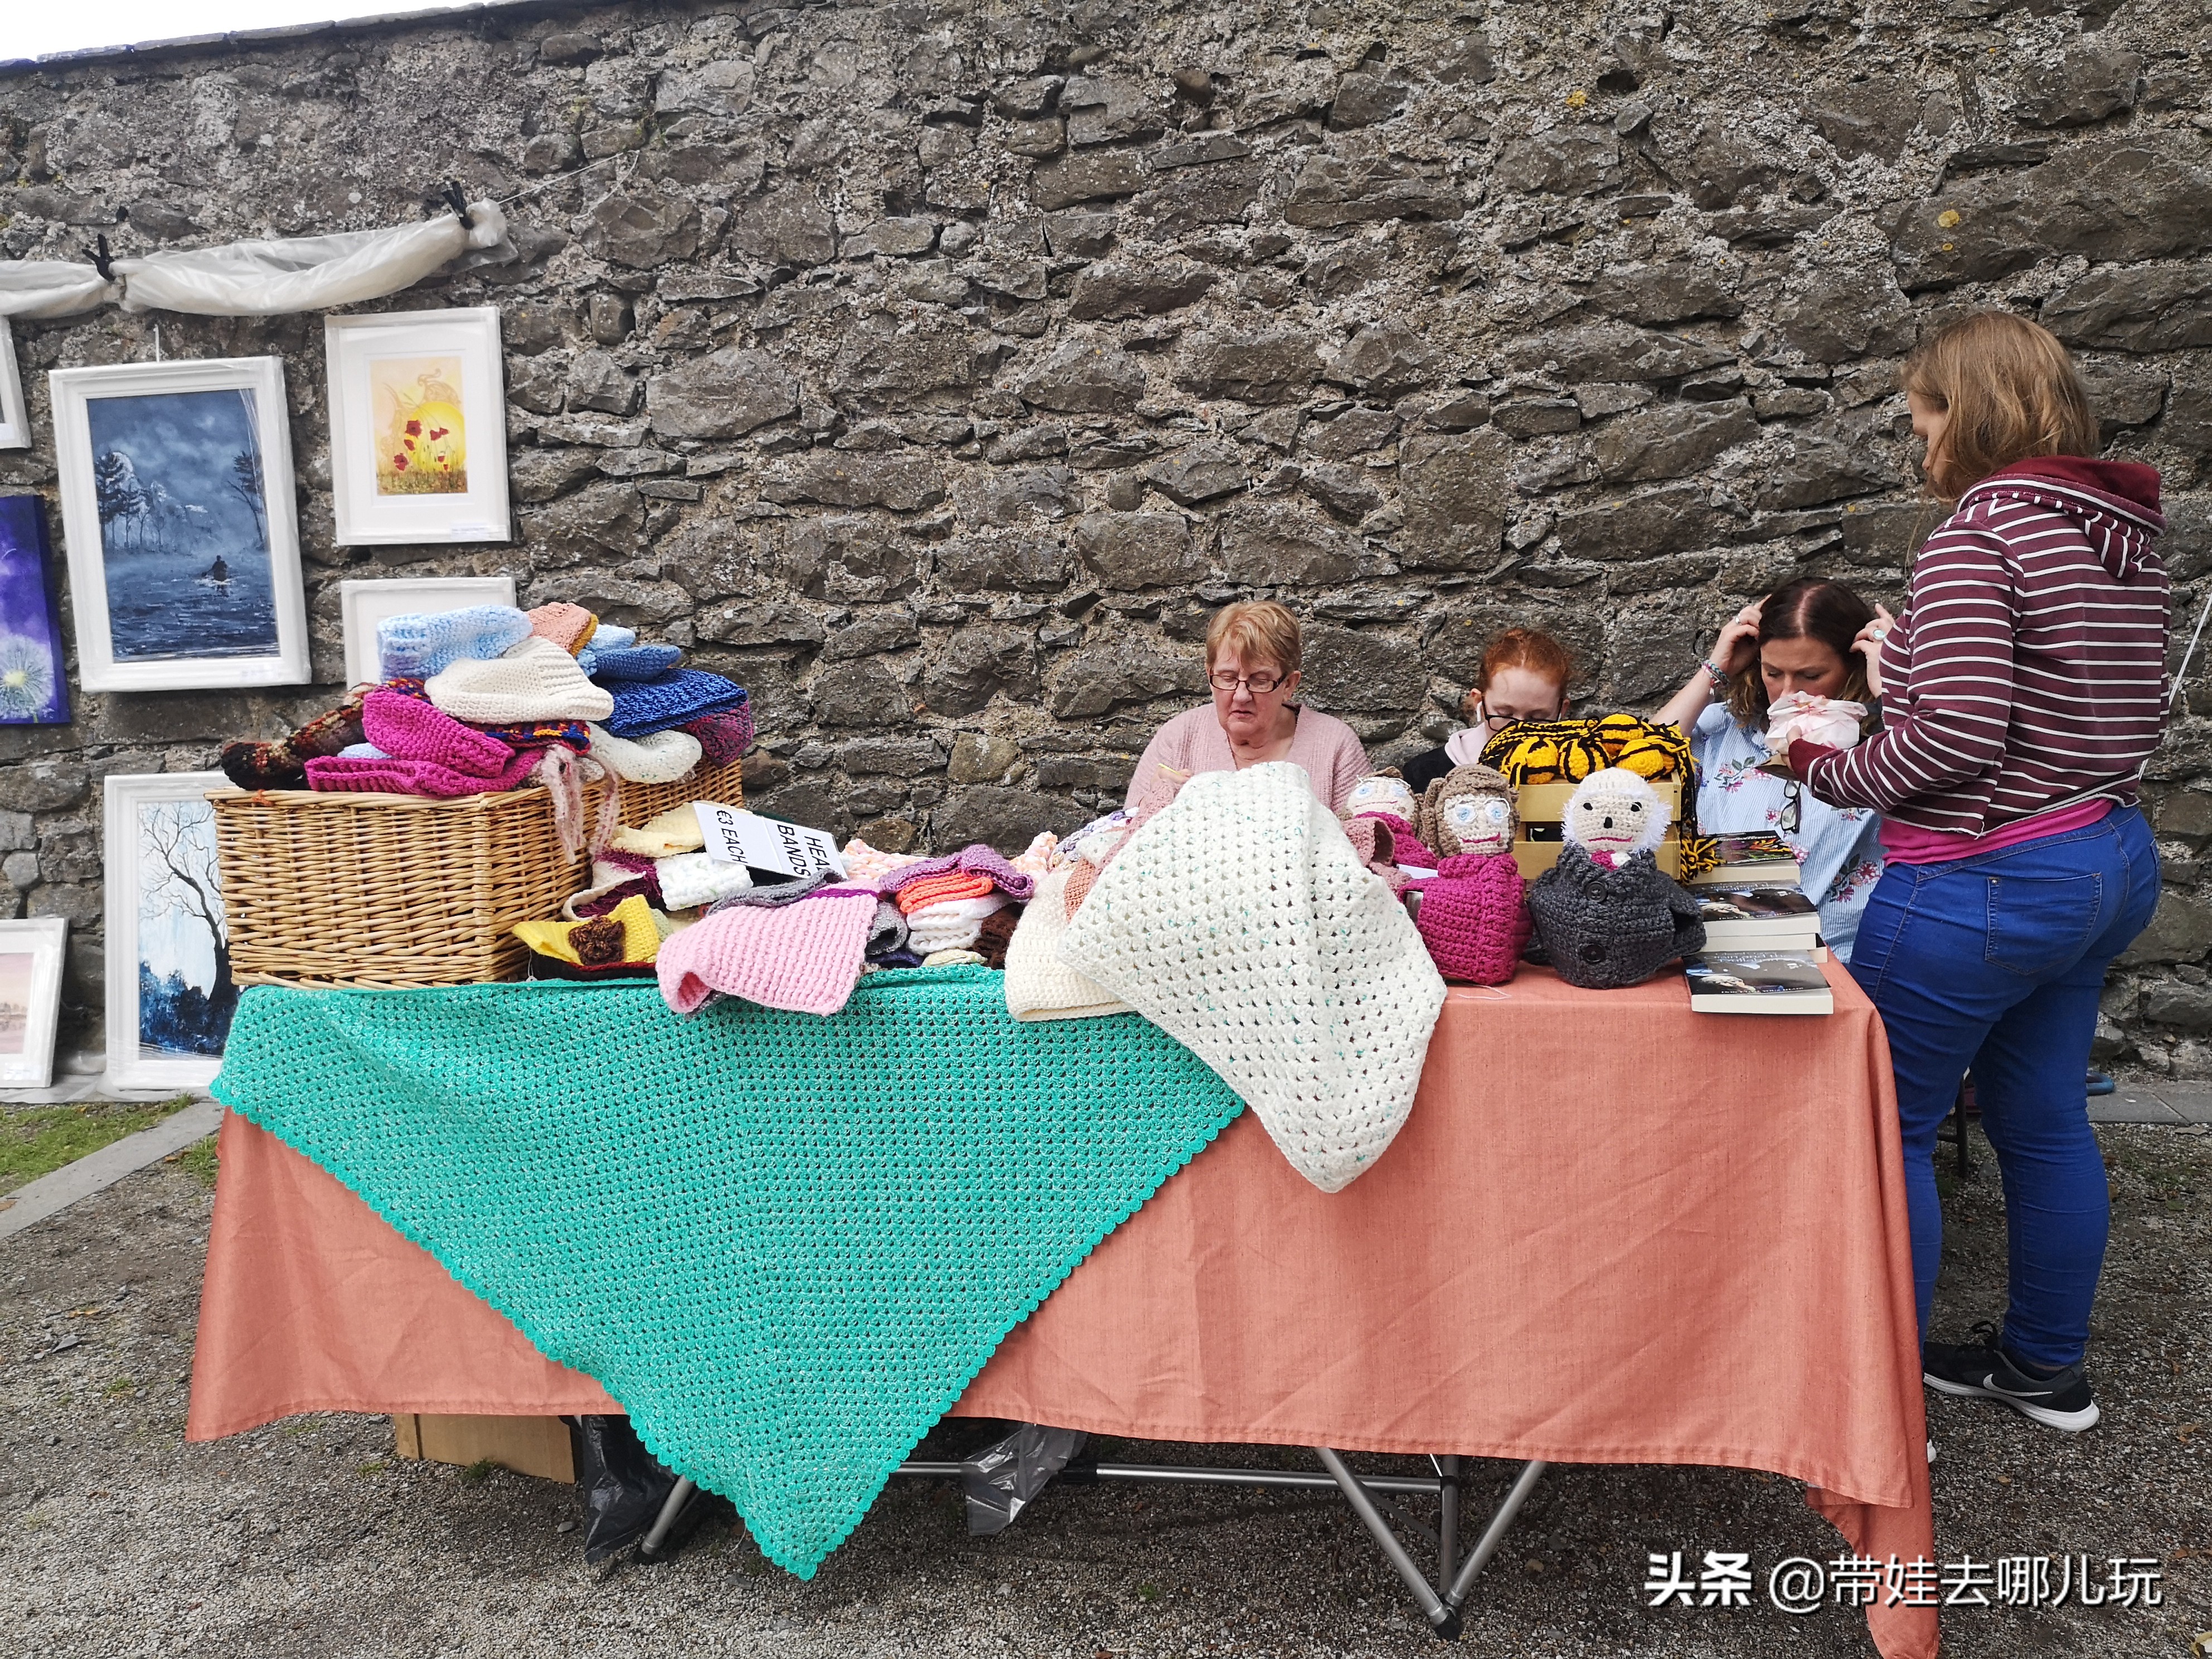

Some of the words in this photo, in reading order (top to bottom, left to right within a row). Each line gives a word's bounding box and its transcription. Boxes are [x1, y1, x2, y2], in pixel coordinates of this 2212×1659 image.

[716, 810, 734, 825] €3
[721, 828, 748, 864] EACH
[777, 824, 811, 877] BANDS
[804, 835, 831, 871] HEA
